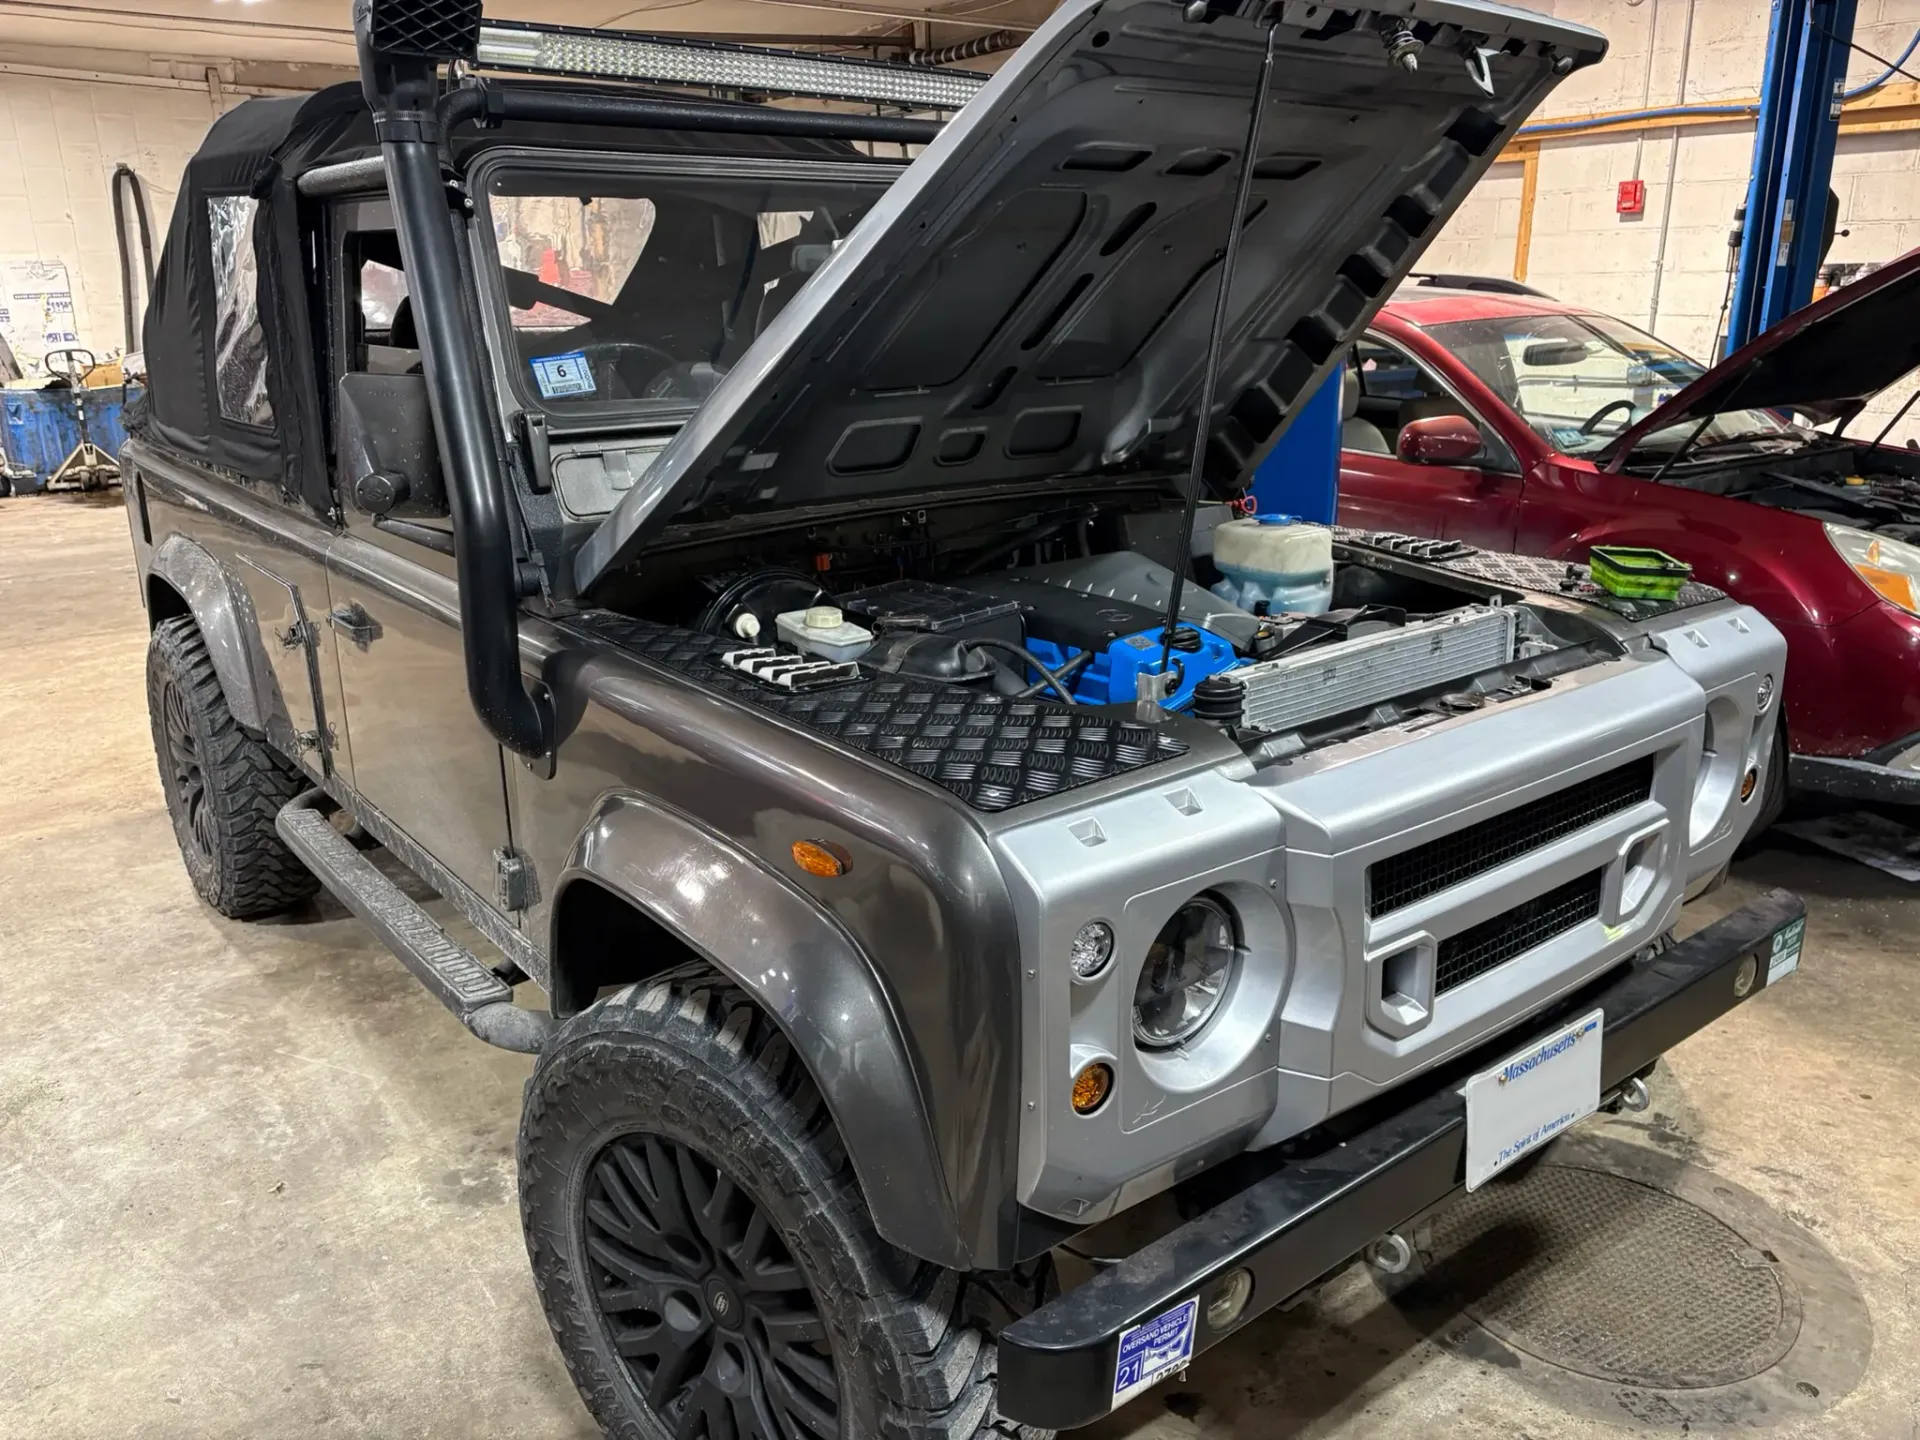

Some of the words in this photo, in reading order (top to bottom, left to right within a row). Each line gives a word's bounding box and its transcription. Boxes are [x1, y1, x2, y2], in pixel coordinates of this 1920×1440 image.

[557, 365, 567, 378] 6
[1503, 1033, 1576, 1082] Massachusetts
[1499, 1147, 1512, 1163] The
[1514, 1135, 1532, 1152] Spirit
[1533, 1128, 1541, 1140] of
[1541, 1113, 1570, 1135] America
[1122, 1327, 1160, 1353] OVERSAND
[1160, 1314, 1188, 1334] VEHICLE
[1153, 1326, 1179, 1346] PERMIT
[1118, 1361, 1140, 1390] 21
